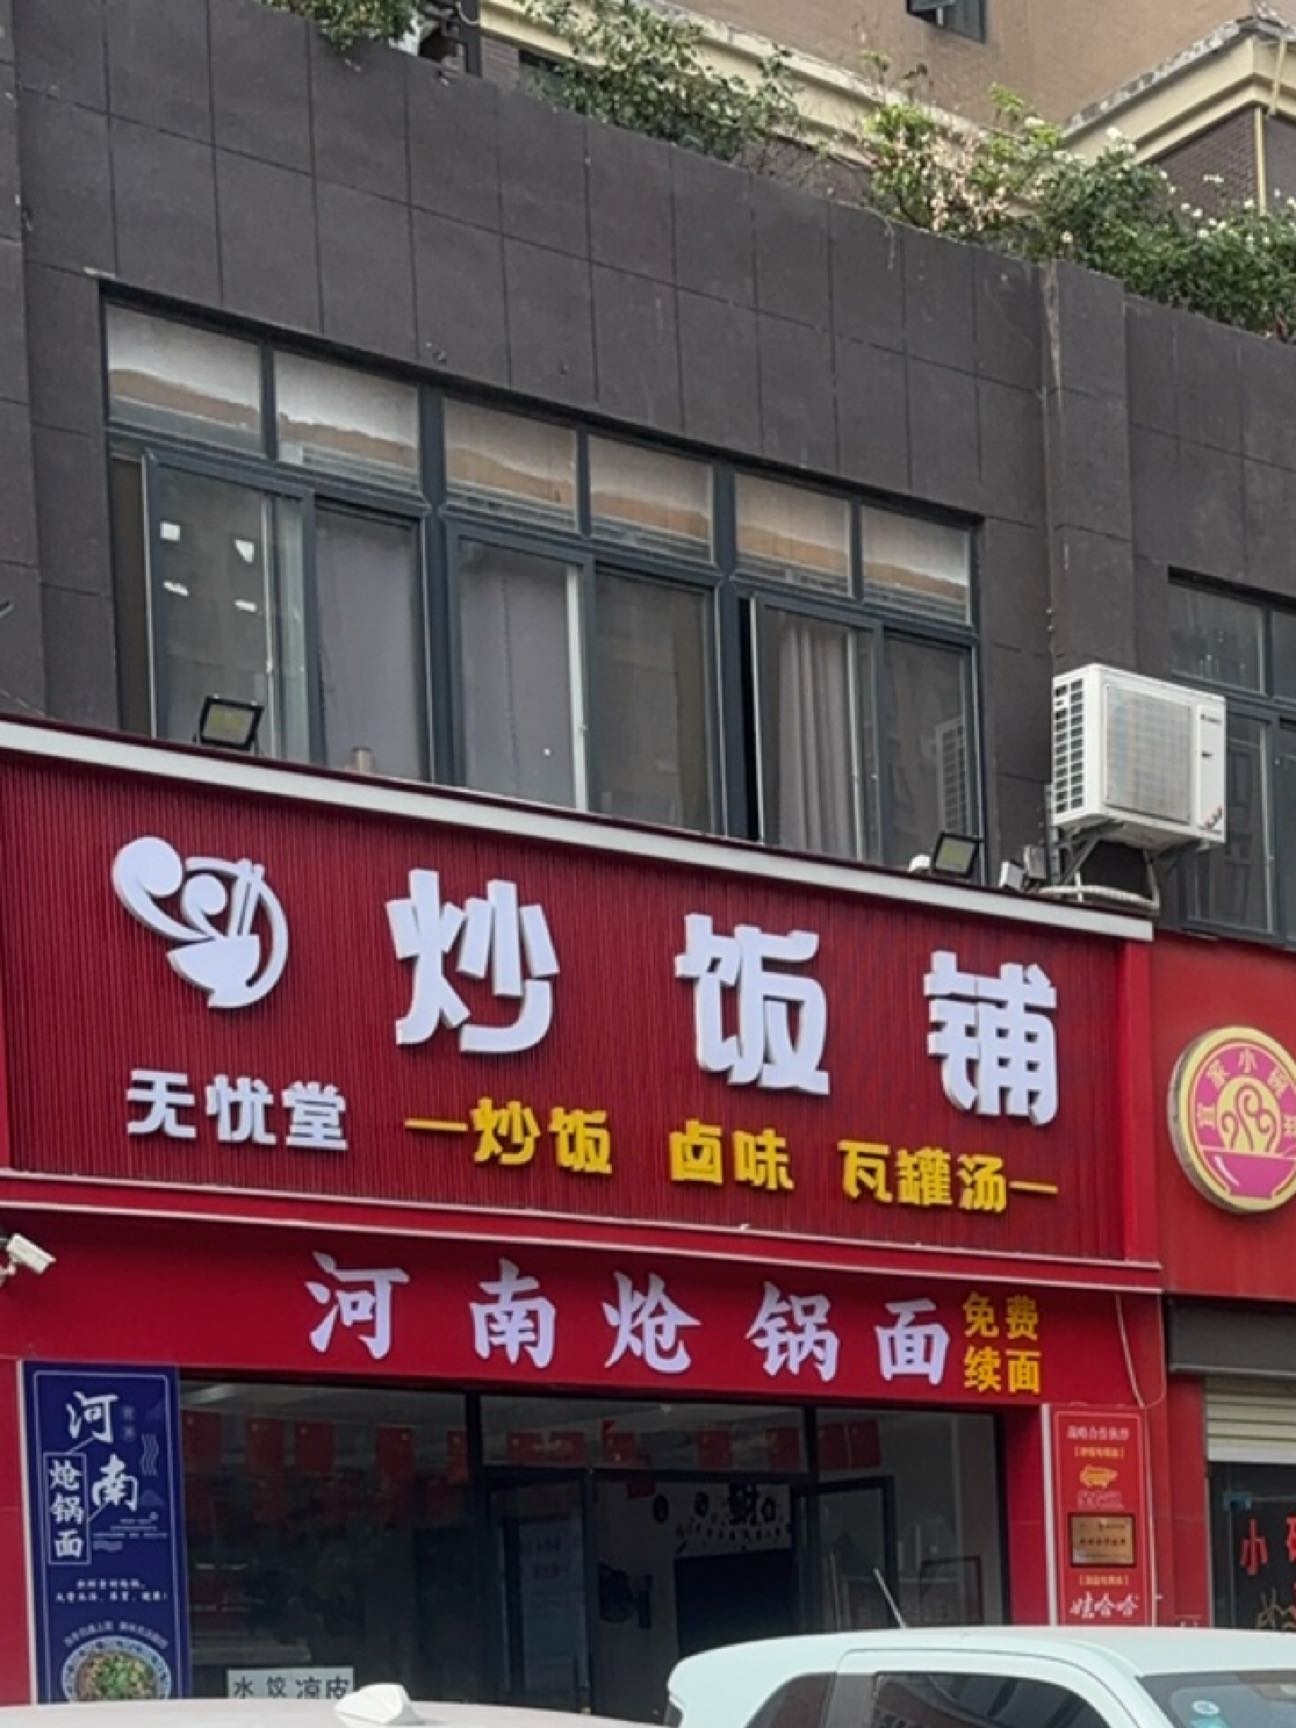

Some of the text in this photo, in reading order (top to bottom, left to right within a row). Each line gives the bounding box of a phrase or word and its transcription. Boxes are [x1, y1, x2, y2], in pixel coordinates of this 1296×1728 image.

[385, 868, 1059, 1126] 炒饭铺
[126, 1067, 349, 1151] 无忧堂
[470, 1096, 1007, 1213] 炒饭 卤味 瓦罐汤
[305, 1251, 951, 1386] 河南炝锅面
[962, 1290, 1040, 1341] 免费
[963, 1345, 1042, 1395] 续面
